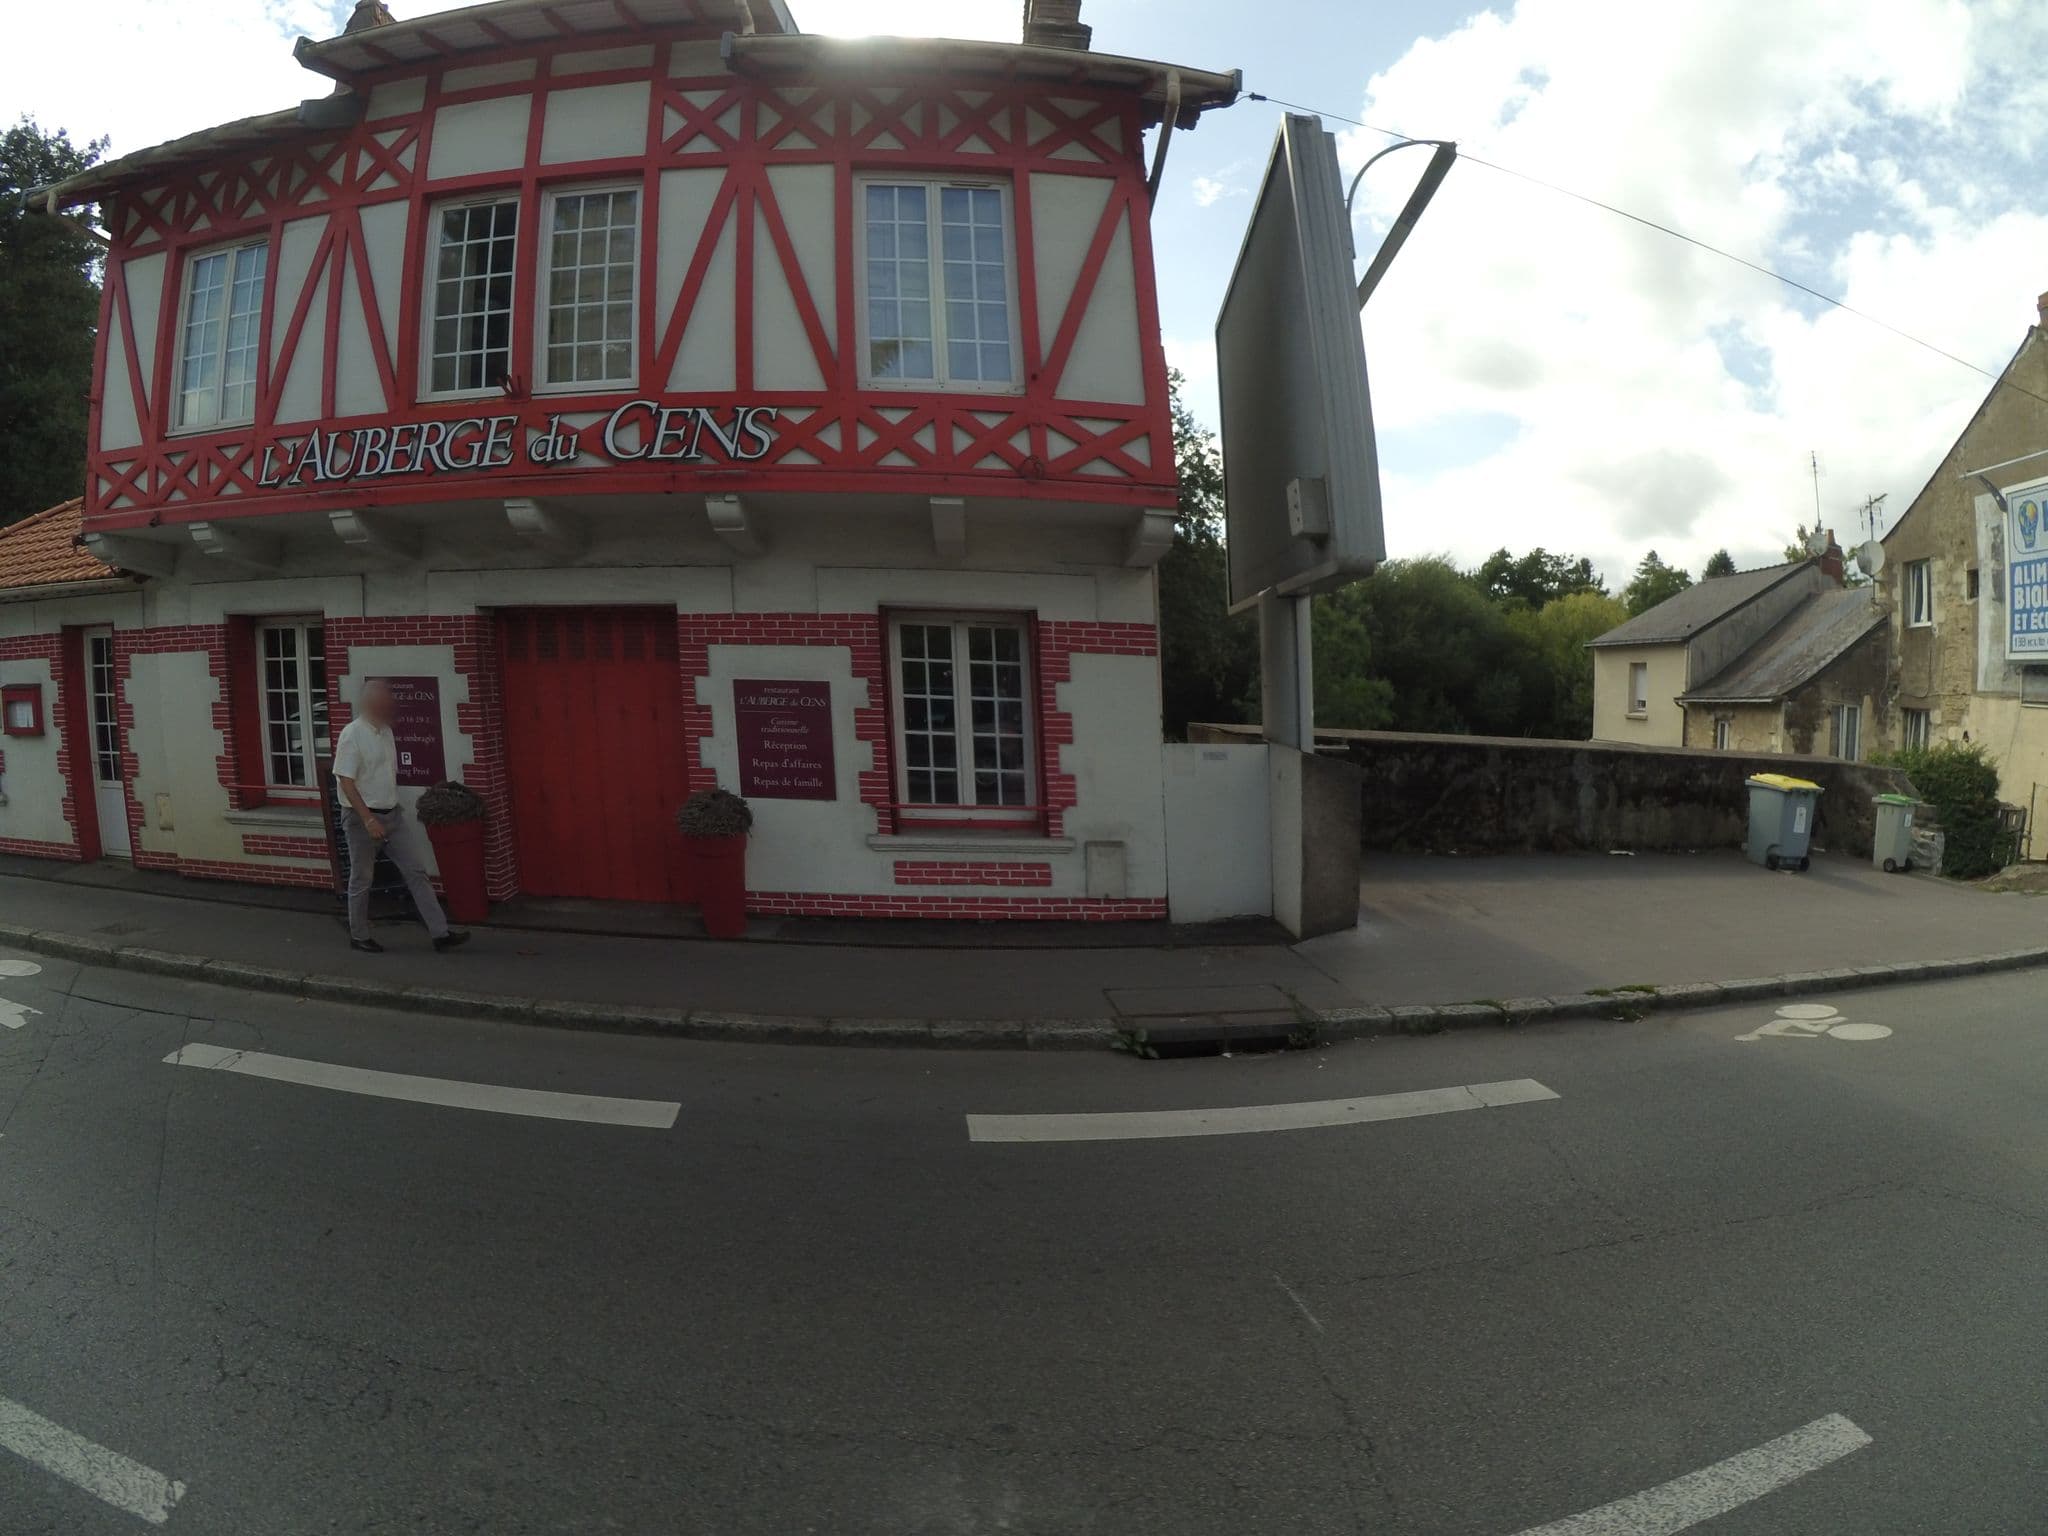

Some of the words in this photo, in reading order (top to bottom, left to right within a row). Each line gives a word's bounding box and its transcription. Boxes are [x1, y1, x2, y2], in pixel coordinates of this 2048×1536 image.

[257, 415, 518, 487] L'AUBERGE
[530, 414, 578, 463] du
[604, 400, 778, 460] CENS
[800, 696, 827, 708] CENS
[764, 740, 808, 752] Réception
[403, 753, 409, 763] P
[752, 758, 779, 770] Repas
[781, 758, 823, 769] d'affaires
[753, 776, 779, 789] Repas
[782, 777, 792, 787] de
[794, 777, 824, 788] famille
